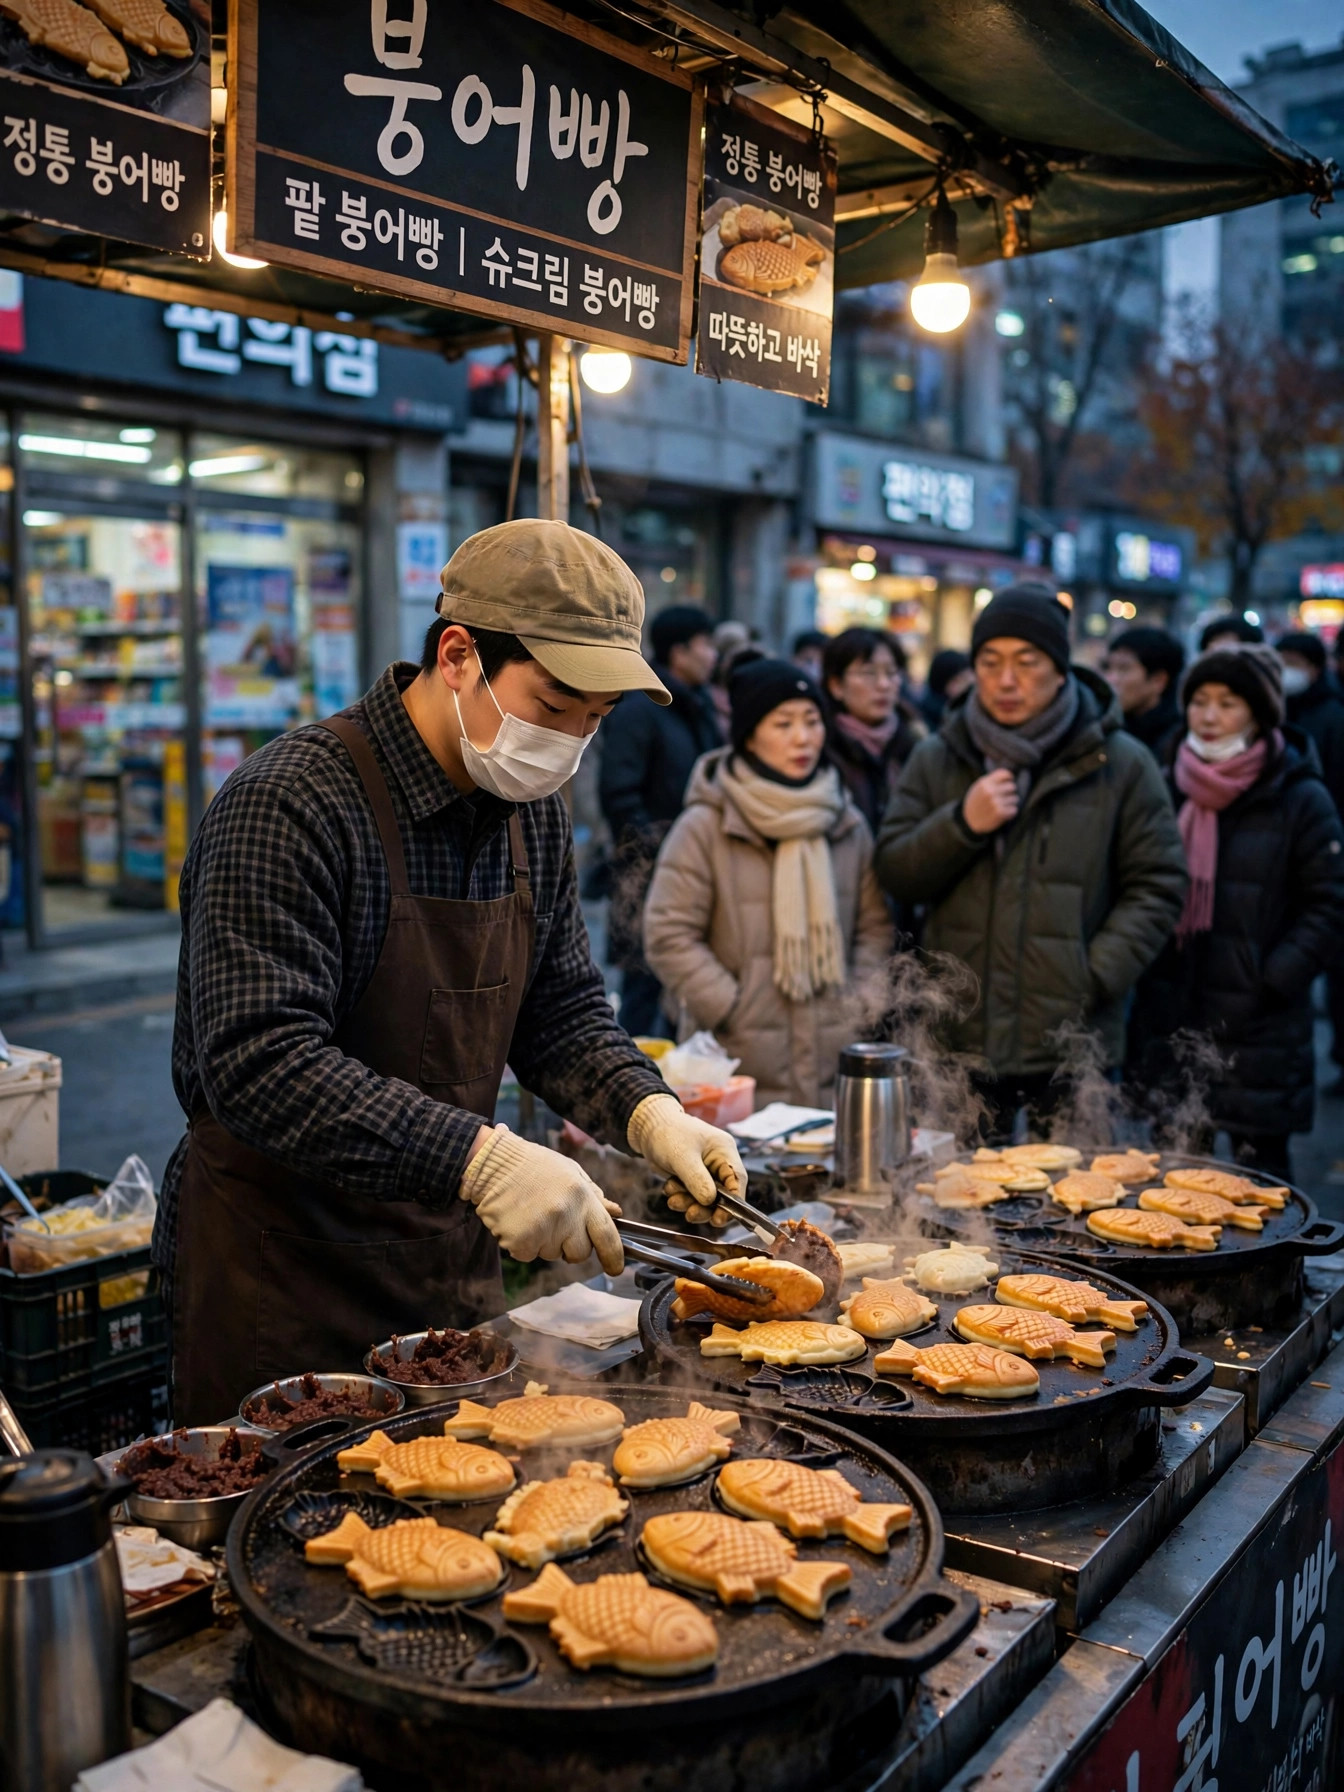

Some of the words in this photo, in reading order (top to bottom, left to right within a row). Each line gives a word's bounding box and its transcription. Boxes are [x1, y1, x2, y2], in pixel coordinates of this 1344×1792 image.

[2, 114, 76, 186] 정통
[85, 136, 187, 212] 붕어빵
[343, 0, 650, 235] 붕어빵
[721, 133, 762, 184] 정통
[766, 150, 822, 209] 붕어빵
[284, 177, 327, 241] 팥
[334, 190, 445, 271] 붕어빵
[481, 236, 571, 307] 슈크림
[579, 263, 661, 331] 붕어빵
[709, 312, 782, 363] 따뜻하고
[786, 335, 822, 379] 바삭
